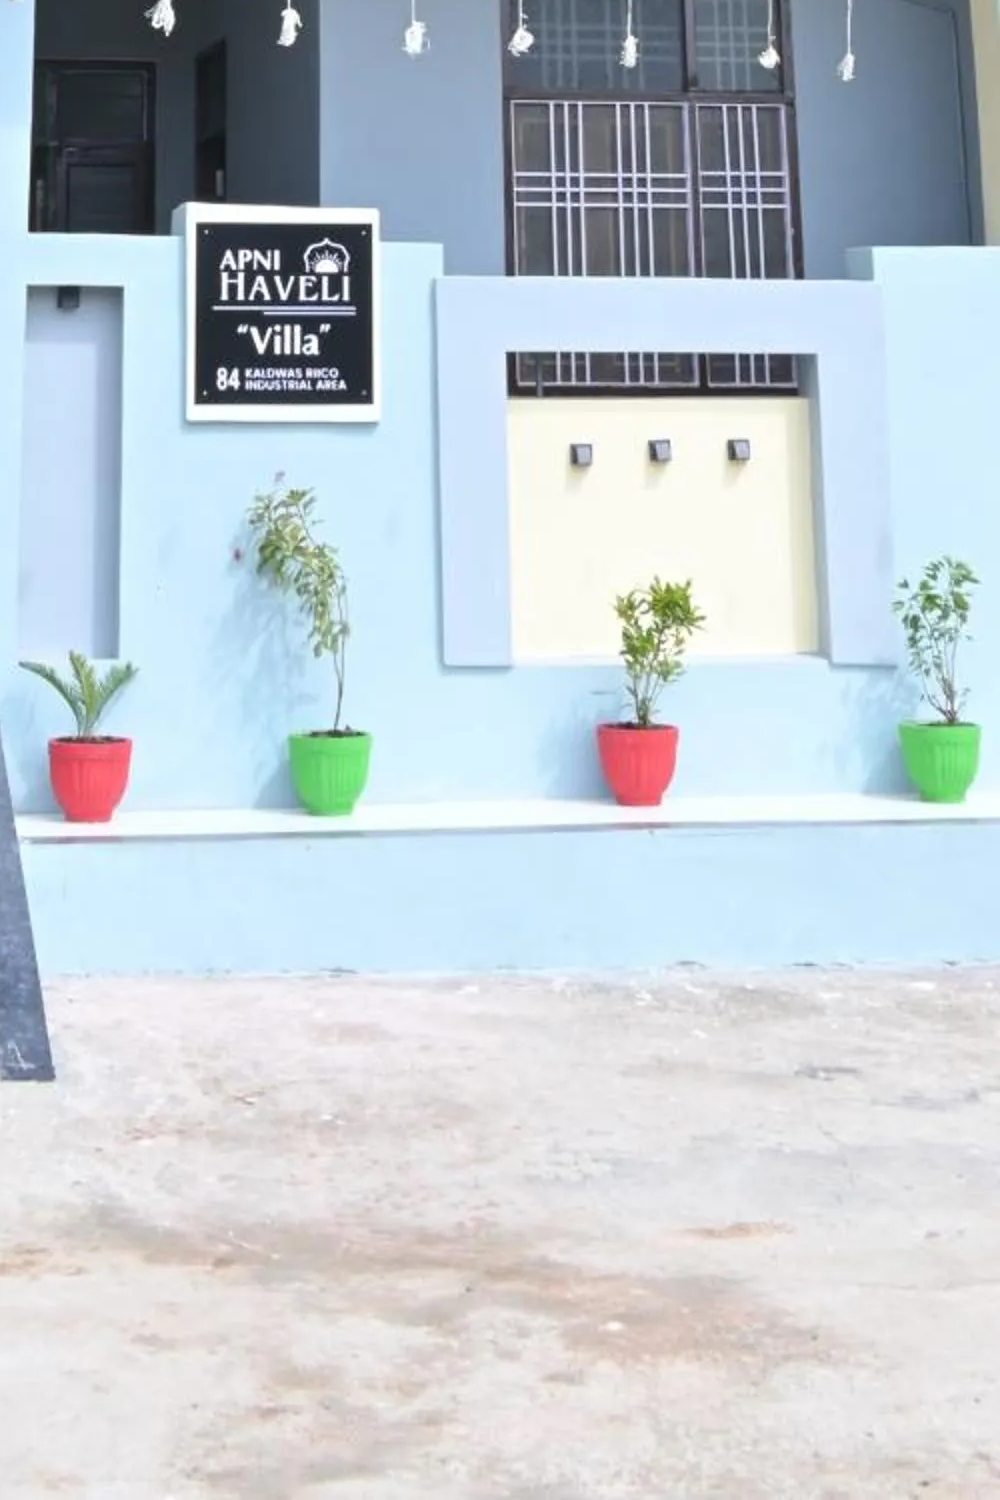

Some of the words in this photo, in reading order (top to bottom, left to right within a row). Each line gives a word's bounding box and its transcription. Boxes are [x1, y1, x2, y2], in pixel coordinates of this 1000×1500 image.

[219, 249, 280, 270] APNI
[220, 272, 350, 301] HAVELI
[216, 367, 240, 391] 84
[244, 367, 303, 379] KALDWAS
[244, 379, 313, 391] INDUSTRIAL
[315, 379, 347, 391] AREA
